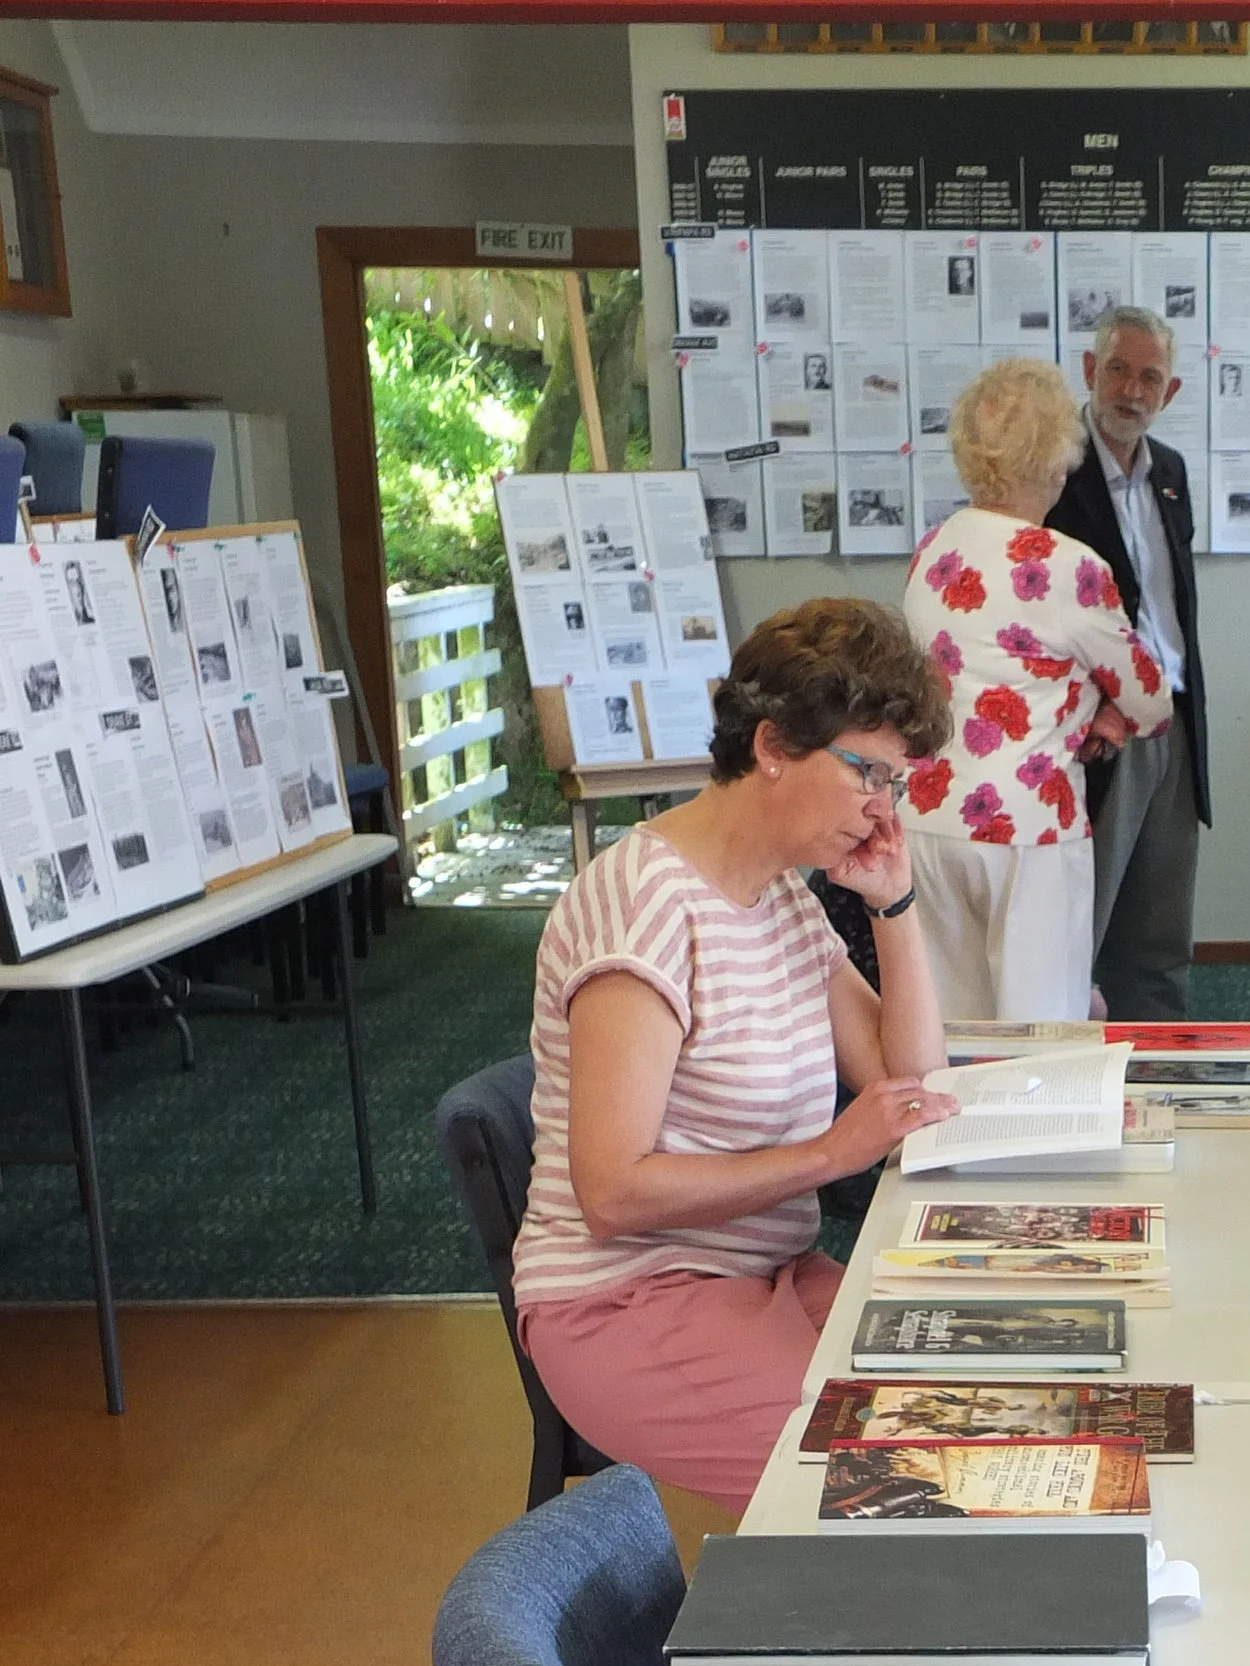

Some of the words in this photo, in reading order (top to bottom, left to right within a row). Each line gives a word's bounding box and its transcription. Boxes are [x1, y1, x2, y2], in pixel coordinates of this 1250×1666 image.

[1084, 134, 1118, 149] MEN
[480, 229, 520, 249] FIRE
[527, 229, 567, 251] EXIT
